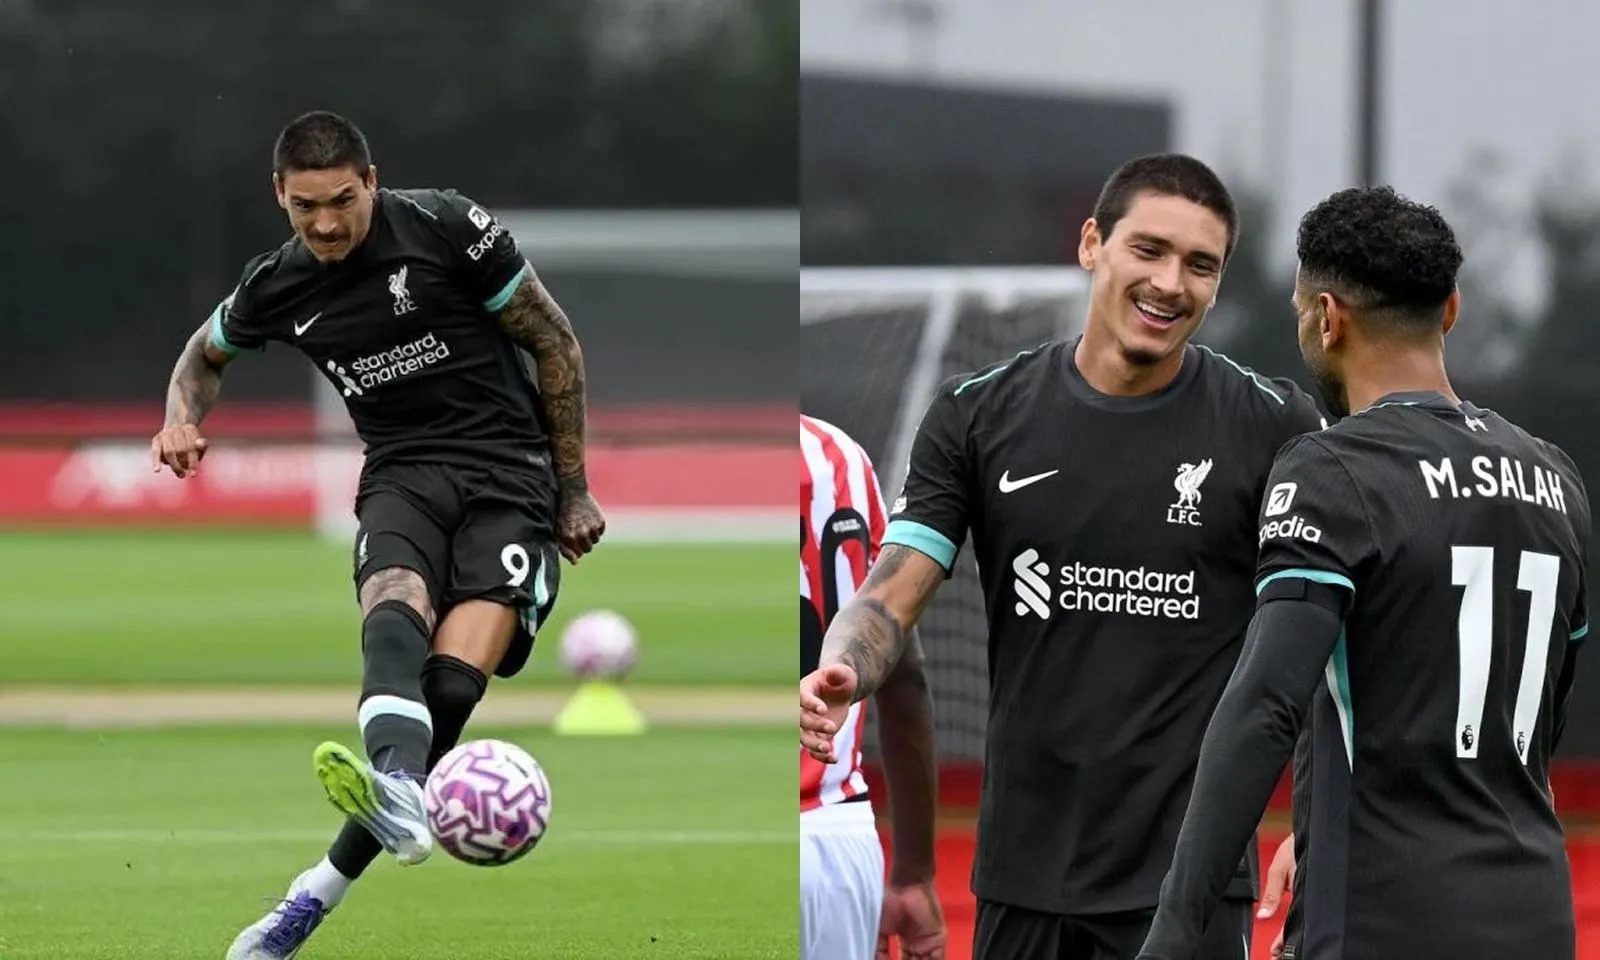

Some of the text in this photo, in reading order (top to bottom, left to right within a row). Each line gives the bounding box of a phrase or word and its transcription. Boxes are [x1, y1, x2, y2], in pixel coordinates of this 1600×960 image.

[467, 217, 503, 260] Expe
[352, 332, 437, 375] standard
[360, 341, 450, 388] chartered
[1418, 455, 1567, 515] M.SALAH
[501, 543, 530, 587] 9
[1059, 561, 1195, 594] standard
[1059, 586, 1200, 620] chartered
[1451, 546, 1560, 766] 11
